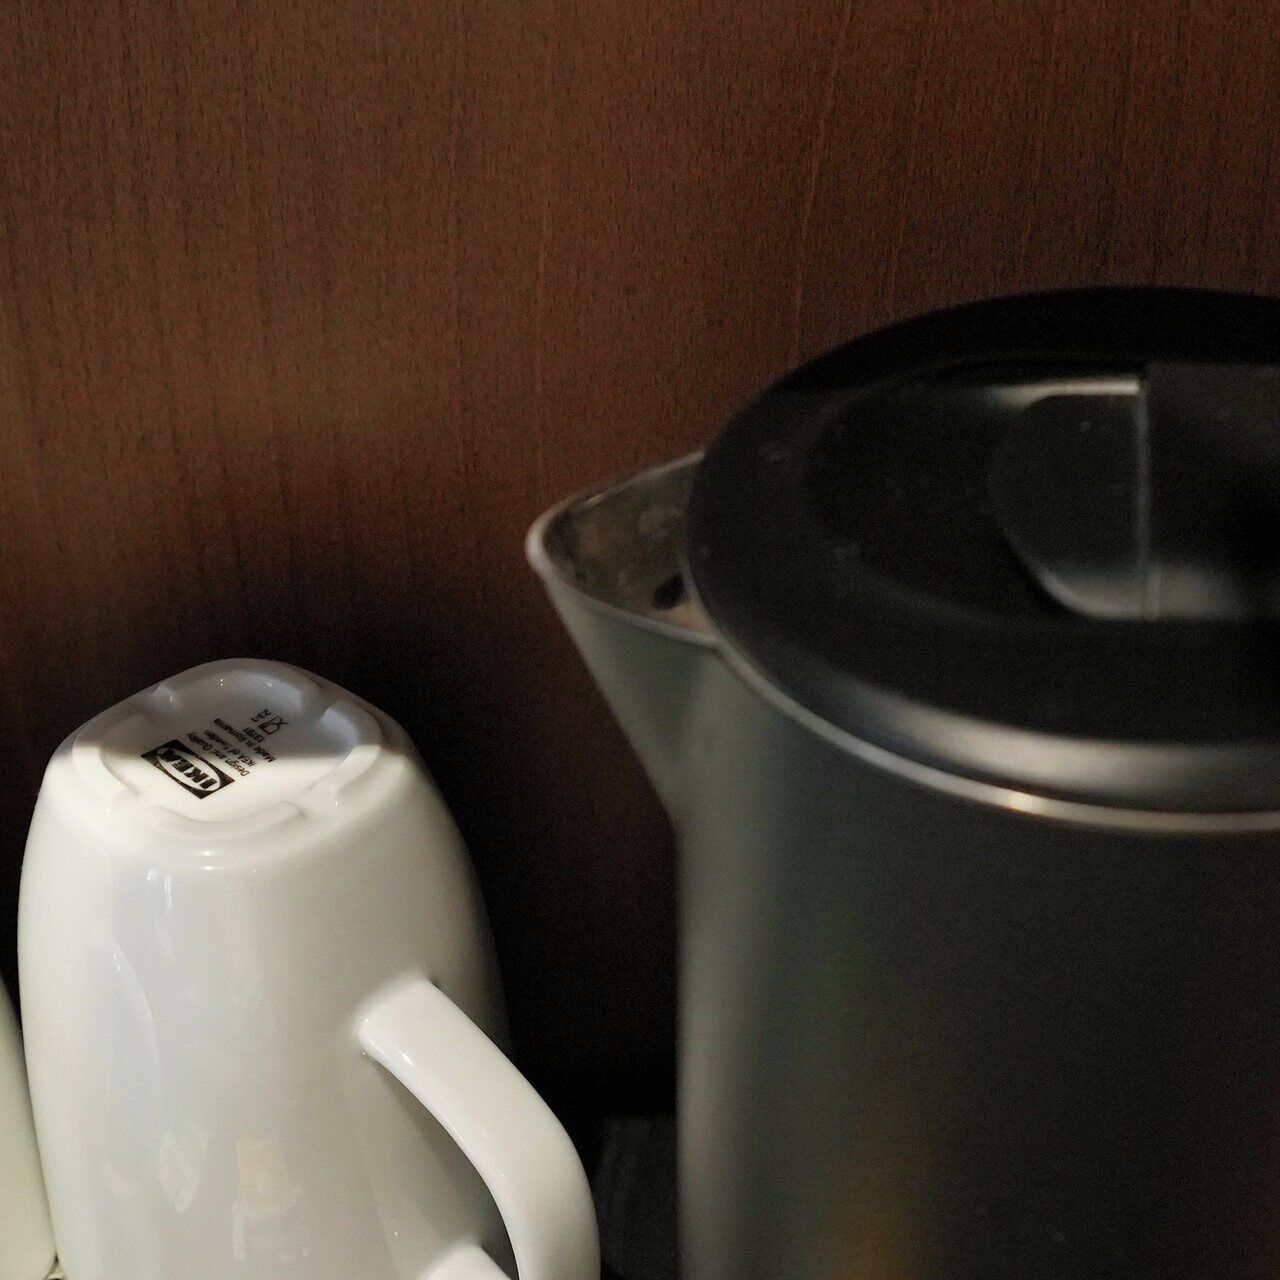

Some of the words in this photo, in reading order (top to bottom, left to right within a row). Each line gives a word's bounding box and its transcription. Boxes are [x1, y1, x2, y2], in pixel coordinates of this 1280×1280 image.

[253, 745, 278, 763] Made
[160, 749, 217, 789] IKEA
[225, 757, 250, 777] Design
